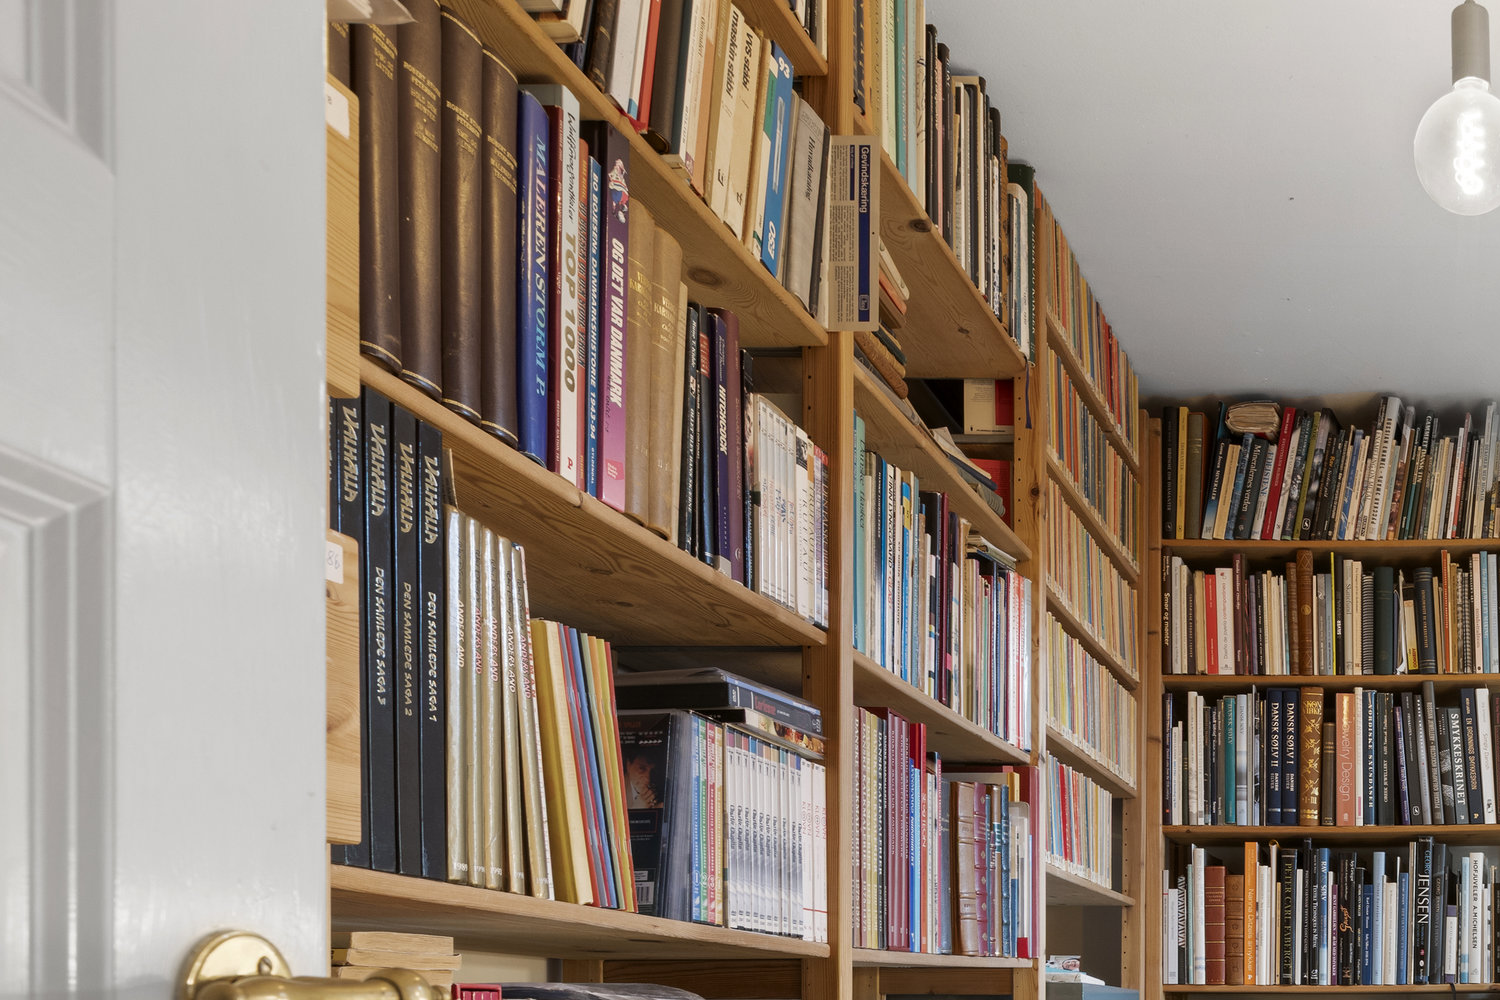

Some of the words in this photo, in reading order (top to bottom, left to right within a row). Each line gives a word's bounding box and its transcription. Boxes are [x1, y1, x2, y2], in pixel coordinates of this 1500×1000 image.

[729, 10, 739, 60] maskin
[725, 60, 737, 99] ståbi
[743, 57, 752, 92] ståbi
[778, 56, 791, 79] 93
[592, 172, 600, 192] BO
[859, 146, 870, 214] Gevindskæring
[535, 136, 547, 272] MALEREN
[565, 231, 577, 300] TOP
[611, 237, 625, 262] OG
[611, 262, 625, 291] DET
[535, 272, 546, 374] STORM
[589, 258, 600, 387] DANMARKSHISTORIE
[610, 291, 624, 326] VAR
[564, 309, 577, 393] 1000
[609, 325, 624, 408] DANMARK
[536, 376, 546, 397] P.
[718, 384, 727, 456] HITCHCOCK
[341, 407, 360, 503] VALHALLA
[369, 422, 386, 517] VALHALLA
[399, 442, 414, 534] VALHALLA
[423, 455, 440, 544] VALHALLA
[374, 566, 385, 595] DEN
[403, 582, 412, 609] DEN
[427, 591, 437, 618] DEN
[375, 598, 385, 658] SAMLEDE
[403, 611, 412, 671] SAMLEDE
[427, 620, 437, 677] SAMLEDE
[376, 660, 386, 693] SAGA
[403, 673, 412, 706] SAGA
[427, 680, 438, 713] SAGA
[1271, 702, 1280, 733] DANSK
[1286, 702, 1295, 733] DANSK
[1271, 734, 1280, 759] SØLV
[1286, 734, 1295, 759] SØLV
[1450, 713, 1466, 806] SMYKKESKRINET
[1340, 762, 1352, 802] Design
[1284, 862, 1293, 893] PETER
[1424, 849, 1432, 875] GEORG
[1247, 888, 1255, 913] Nanna
[1284, 896, 1293, 920] CARL
[1417, 873, 1431, 925] JENSEN
[1246, 940, 1255, 972] smykker
[1283, 925, 1293, 969] FABERGÉ
